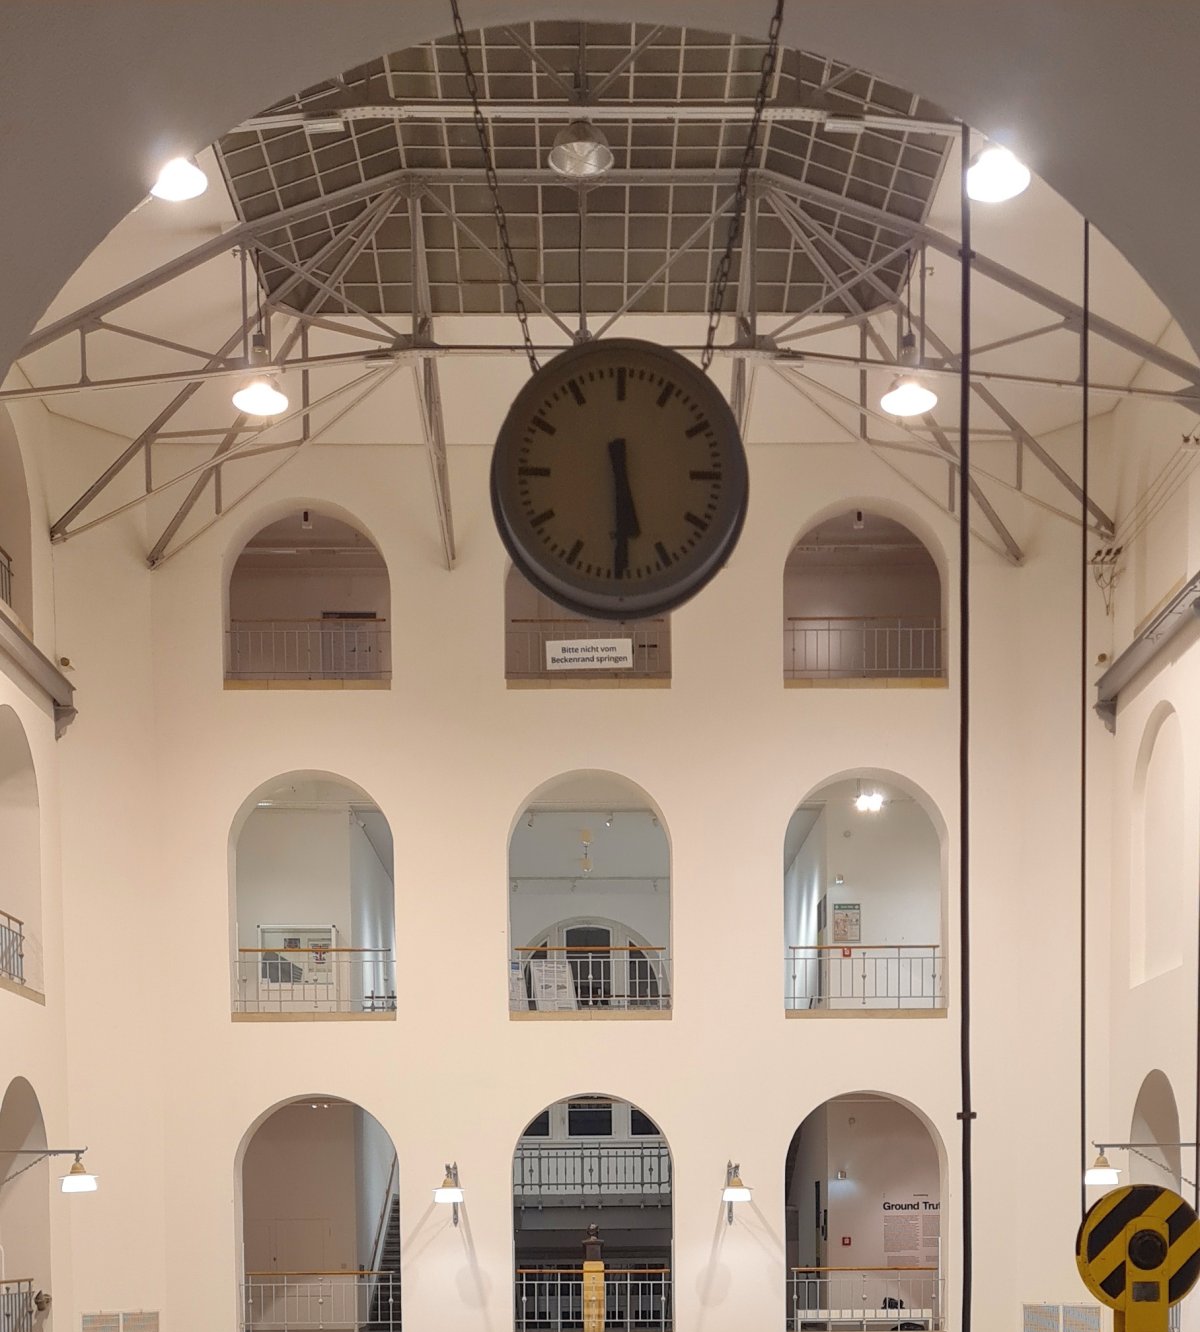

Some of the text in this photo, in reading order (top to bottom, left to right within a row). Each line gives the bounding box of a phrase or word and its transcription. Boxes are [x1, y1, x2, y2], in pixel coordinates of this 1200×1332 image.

[561, 646, 579, 654] Bitte
[580, 645, 599, 653] nicht
[551, 654, 628, 664] Beckenrand springen
[882, 1201, 920, 1211] Ground
